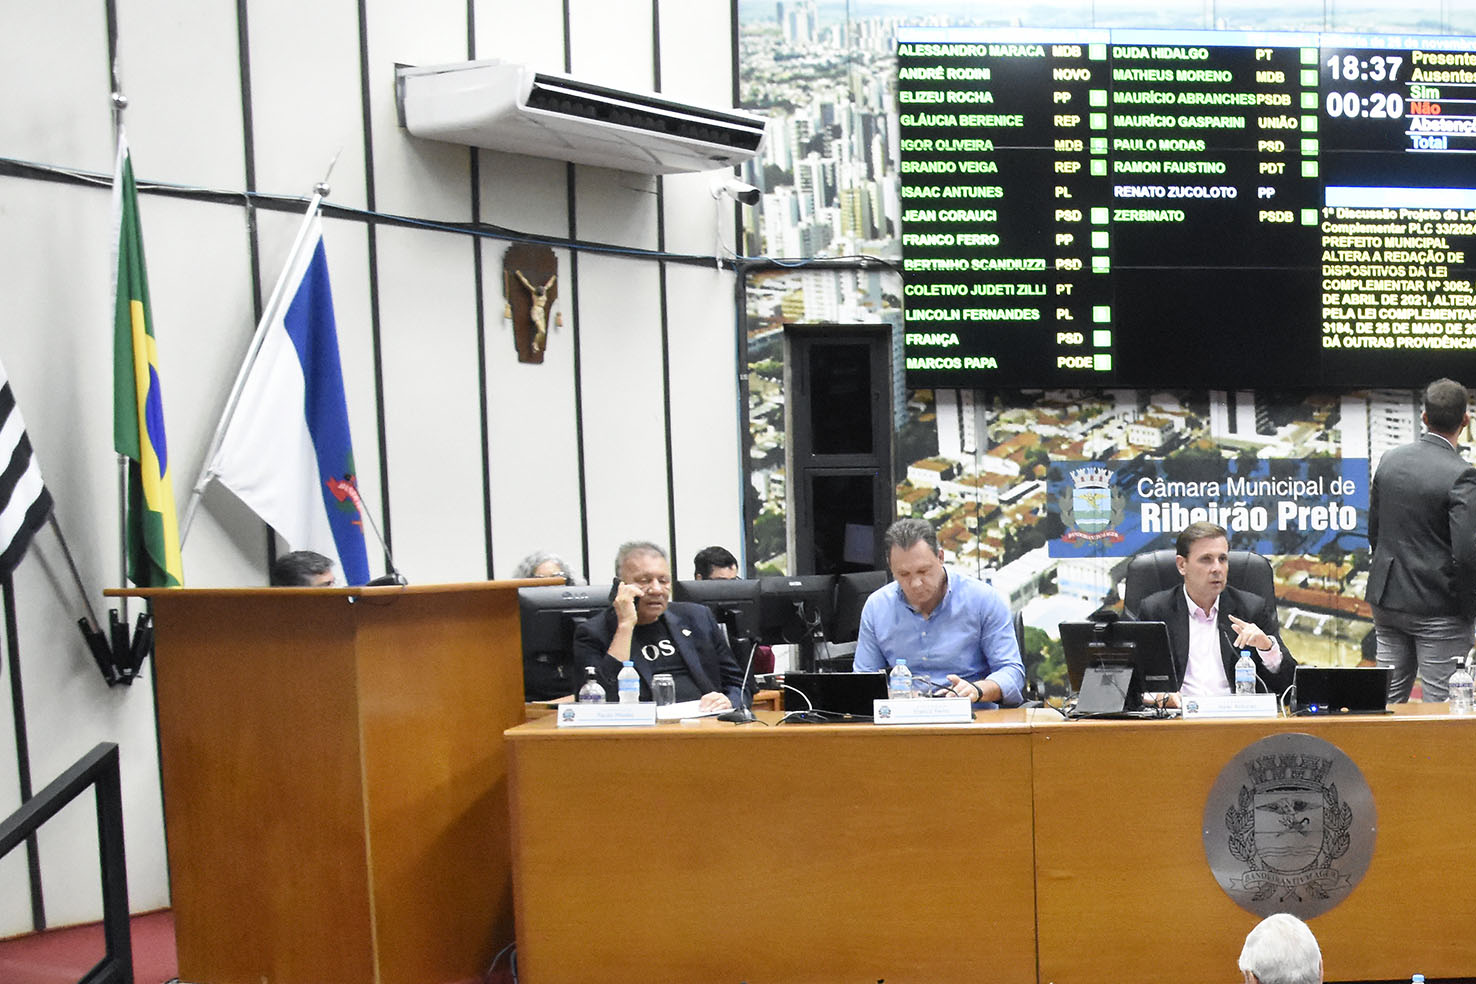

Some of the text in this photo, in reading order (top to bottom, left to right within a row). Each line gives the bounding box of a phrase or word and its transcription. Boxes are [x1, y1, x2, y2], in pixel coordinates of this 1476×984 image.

[899, 45, 987, 57] ALESSANDRO
[1052, 46, 1081, 57] MDB
[1113, 47, 1209, 59] DUDA HIDALGO
[1256, 49, 1273, 60] PT
[947, 68, 990, 80] RODINI
[1327, 55, 1403, 81] 18:37
[1053, 69, 1090, 80] NOVO
[1113, 69, 1232, 82] MATHEUS MORENO
[1256, 71, 1285, 83] MDB
[899, 91, 993, 103] ELIZEU ROCHA
[1054, 92, 1071, 103] PP
[1113, 90, 1256, 105] MAURÍCIO ABRANCHES
[1410, 85, 1440, 99] Sim
[1257, 94, 1291, 105] PSDB
[1326, 92, 1403, 118] 00:20
[1410, 102, 1441, 115] Não
[900, 113, 1023, 126] GLÁUCIA BERENICE
[1054, 115, 1080, 126] REP
[1114, 114, 1245, 128] MAURÍCIO GASPARINI
[1258, 116, 1298, 129] UNIÃO
[901, 140, 994, 151] IGOR OLIVEIRA
[1055, 140, 1083, 151] MDB
[1114, 139, 1205, 151] PAULO MODAS
[1258, 141, 1284, 152] PSD
[1410, 135, 1448, 150] Total
[902, 162, 997, 173] BRANDO VEIGA
[1055, 162, 1081, 173] REP
[1114, 161, 1226, 174] RAMON FAUSTINO
[1260, 163, 1285, 174] PDT
[902, 186, 1003, 198] ISAAC ANTUNES
[1055, 187, 1072, 198] PL
[1114, 186, 1237, 198] RENATO ZUCOLOTO
[1258, 187, 1275, 198] PP
[902, 210, 997, 222] JEAN CORAUCI
[1055, 210, 1082, 221] PSD
[1113, 210, 1184, 221] ZERBINATO
[1259, 211, 1294, 222] PSDB
[1336, 208, 1397, 220] Discussão
[1400, 209, 1441, 222] Projeto
[1444, 210, 1458, 221] de
[1322, 222, 1406, 235] Complementar
[1408, 223, 1433, 234] PLC
[903, 234, 999, 246] FRANCO FERRO
[1056, 234, 1073, 246] PP
[1322, 236, 1449, 248] PREFEITO MUNICIPAL
[1322, 250, 1464, 264] ALTERA A REDAÇÃO DE
[904, 259, 1046, 270] BERTINHO SCANDIUZZI
[1056, 259, 1082, 270] PSD
[1322, 266, 1448, 277] DISPOSITIVOS DA LEI
[905, 285, 1046, 295] COLETIVO JUDETI ZILLI
[1056, 284, 1073, 295] PT
[1322, 280, 1424, 291] COMPLEMENTAR
[1323, 294, 1340, 305] DE
[1342, 294, 1379, 305] ABRIL
[1381, 294, 1398, 305] DE
[906, 309, 1040, 320] LINCOLN FERNANDES
[1057, 308, 1073, 320] PL
[1323, 308, 1355, 319] PELA
[1358, 309, 1376, 319] LEI
[1356, 323, 1373, 334] DE
[1393, 323, 1409, 334] DE
[1412, 323, 1443, 334] MAIO
[1446, 323, 1462, 334] DE
[906, 333, 959, 347] FRANÇA
[1057, 333, 1083, 344] PSD
[1343, 337, 1394, 348] OUTRAS
[907, 357, 997, 369] MARCOS PAPA
[1057, 357, 1093, 368] PODE
[1137, 477, 1356, 500] Câmara Municipal de
[1141, 501, 1357, 532] Ribeirão Preto
[641, 639, 675, 661] OS
